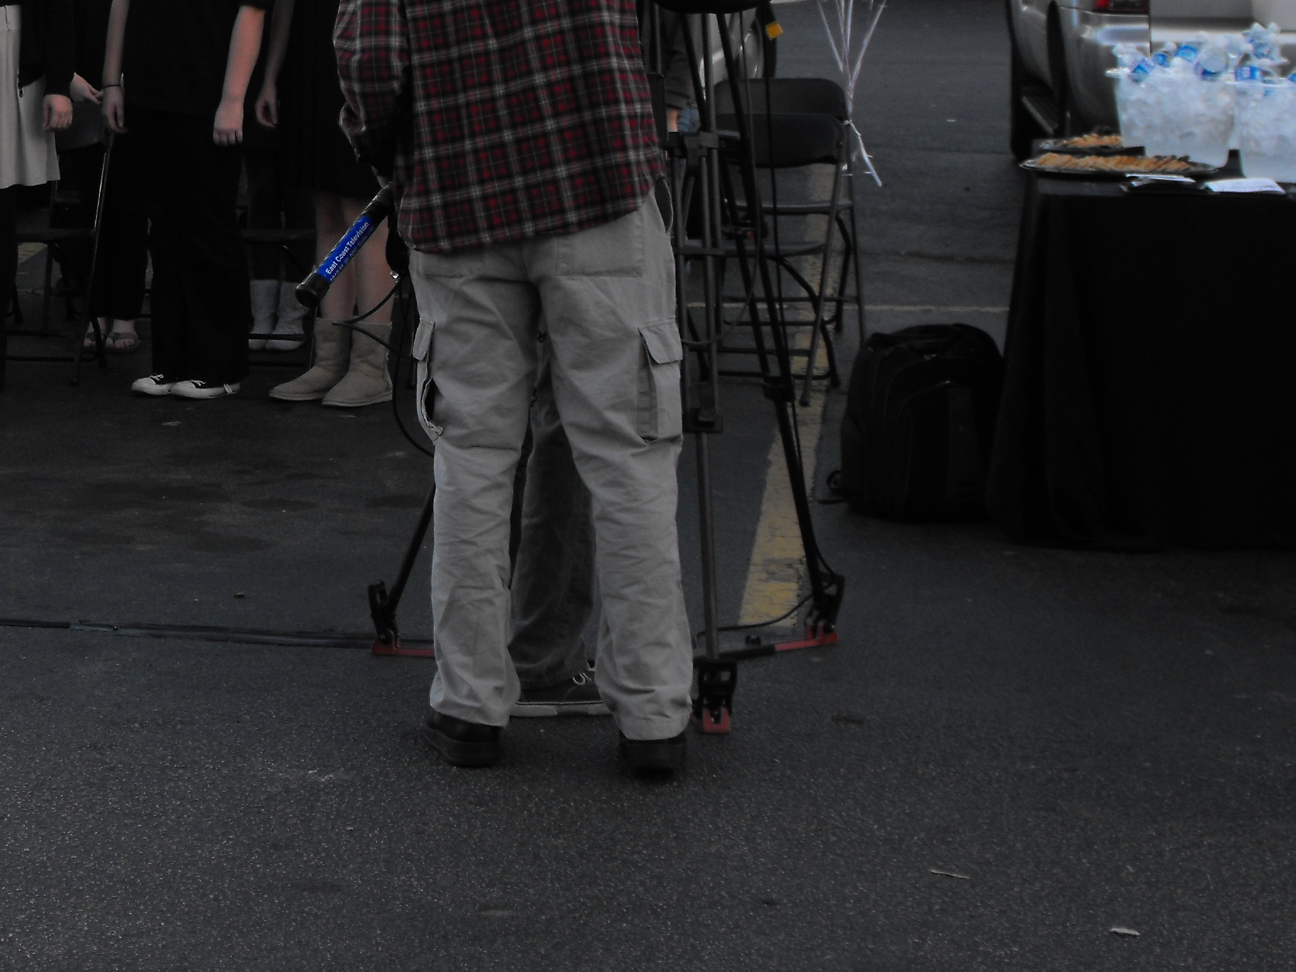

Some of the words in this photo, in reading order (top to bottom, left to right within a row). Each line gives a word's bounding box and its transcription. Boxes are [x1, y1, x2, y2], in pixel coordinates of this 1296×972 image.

[325, 261, 338, 274] East
[335, 246, 350, 263] Coast
[346, 222, 370, 247] Television
